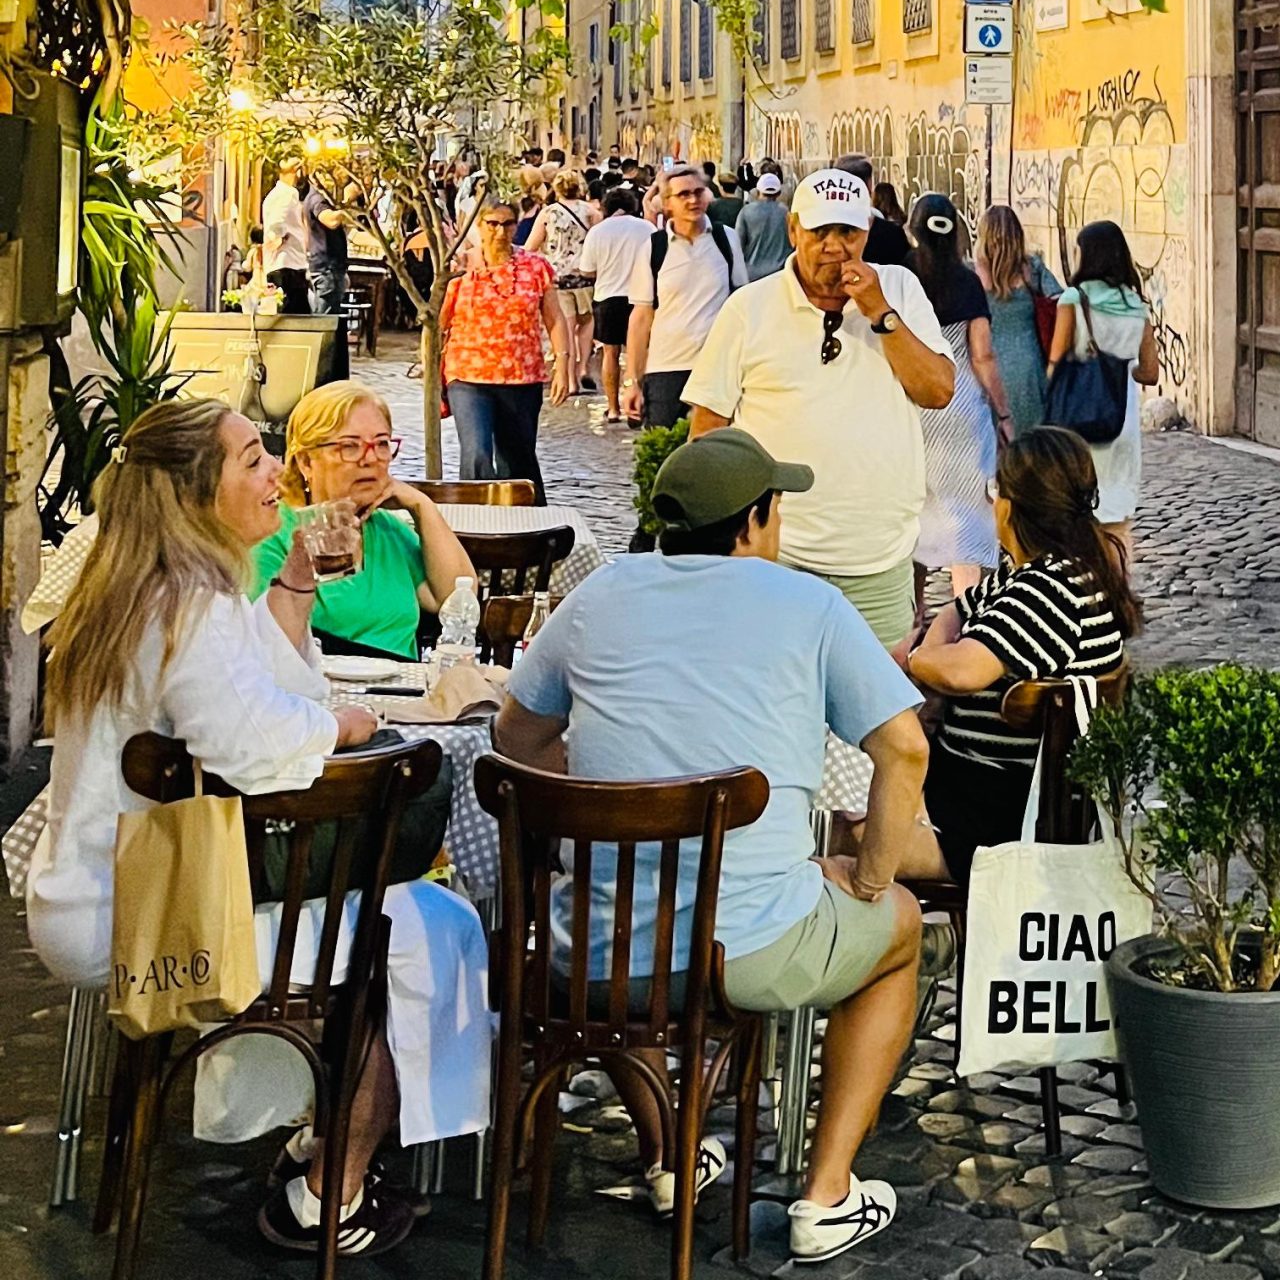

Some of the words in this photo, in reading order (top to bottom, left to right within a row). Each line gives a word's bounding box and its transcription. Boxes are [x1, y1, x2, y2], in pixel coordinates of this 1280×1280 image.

[813, 178, 861, 199] ITALIA
[1019, 910, 1117, 962] CIAO
[987, 980, 1121, 1034] BELL
